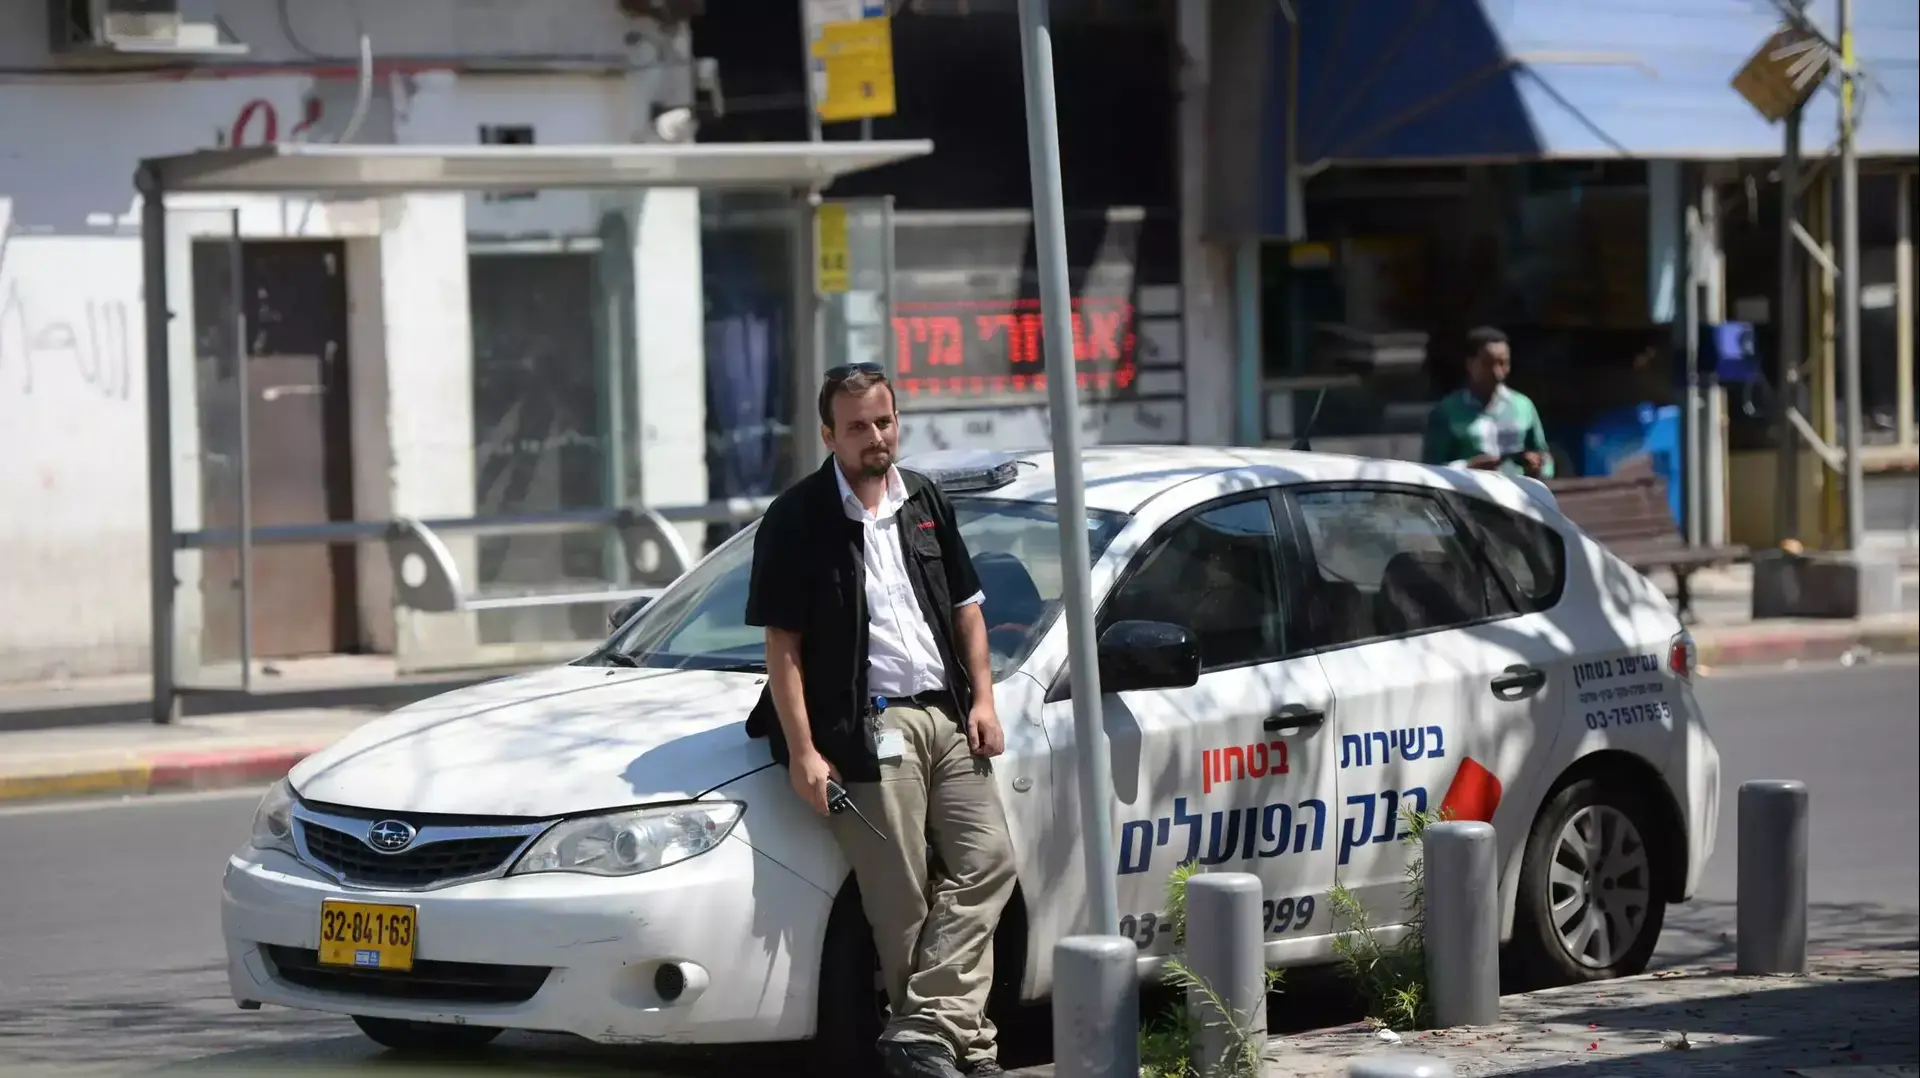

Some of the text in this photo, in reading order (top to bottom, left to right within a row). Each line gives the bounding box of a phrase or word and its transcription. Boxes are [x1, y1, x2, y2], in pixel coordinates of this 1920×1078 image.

[892, 316, 963, 374] מין
[1573, 660, 1613, 689] בטחון
[1586, 702, 1671, 730] 03-7517555
[1202, 725, 1445, 794] בשירות בטחון
[1118, 787, 1428, 875] בנק הפועלים
